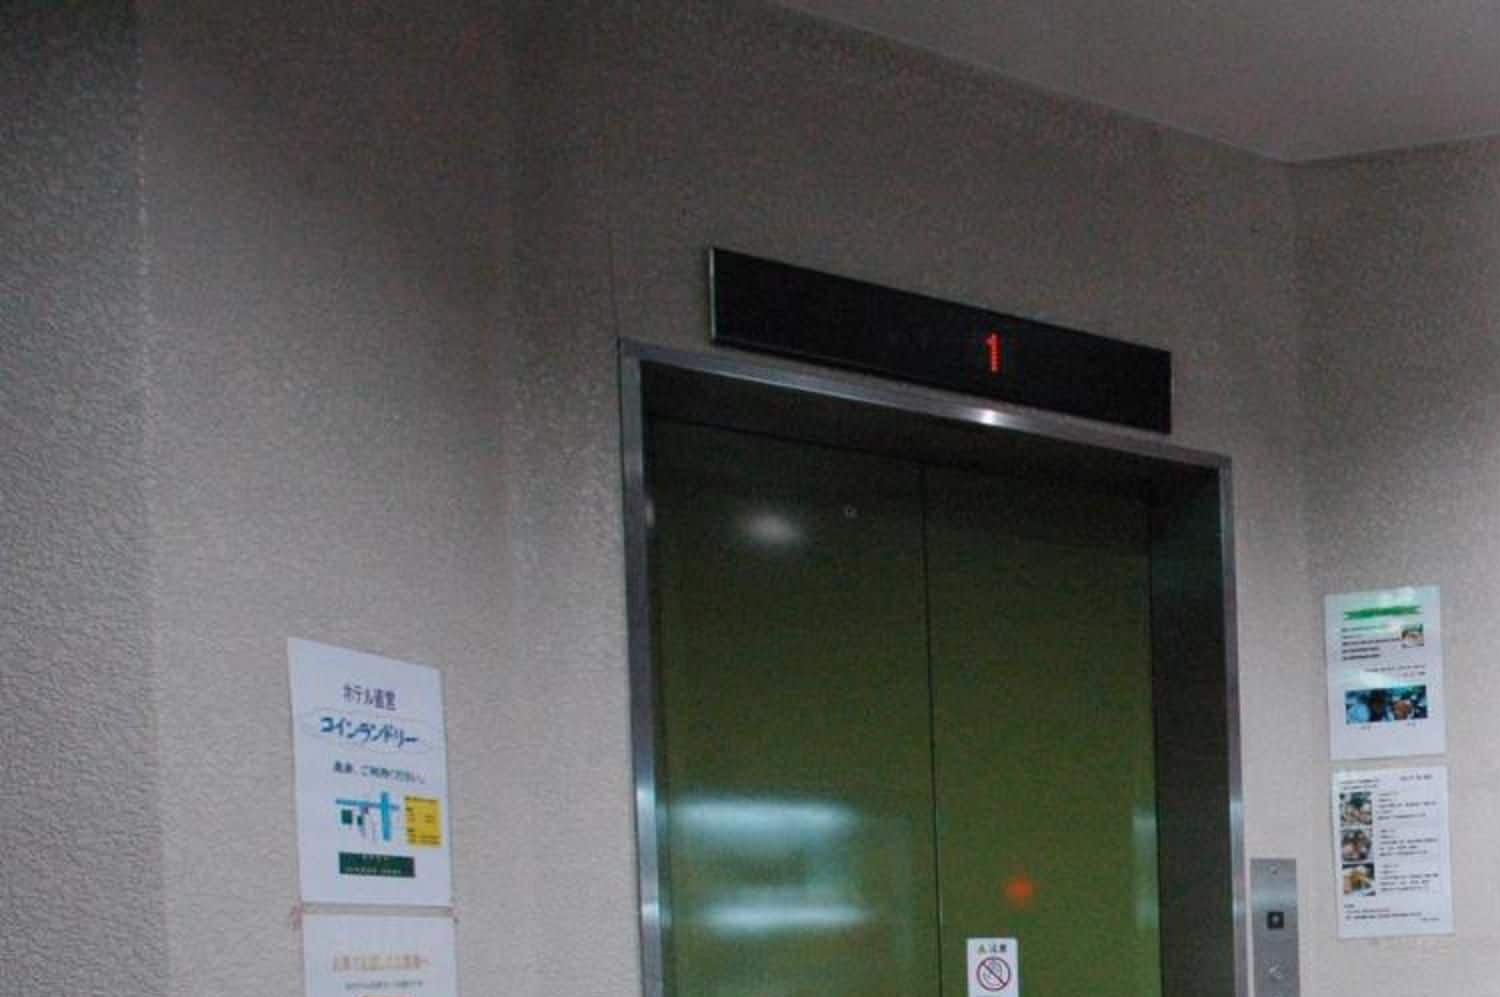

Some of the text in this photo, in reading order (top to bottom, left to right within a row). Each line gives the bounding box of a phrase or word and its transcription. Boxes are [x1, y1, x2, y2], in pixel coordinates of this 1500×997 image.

[986, 332, 1000, 373] 1
[319, 715, 420, 748] コインランドリー
